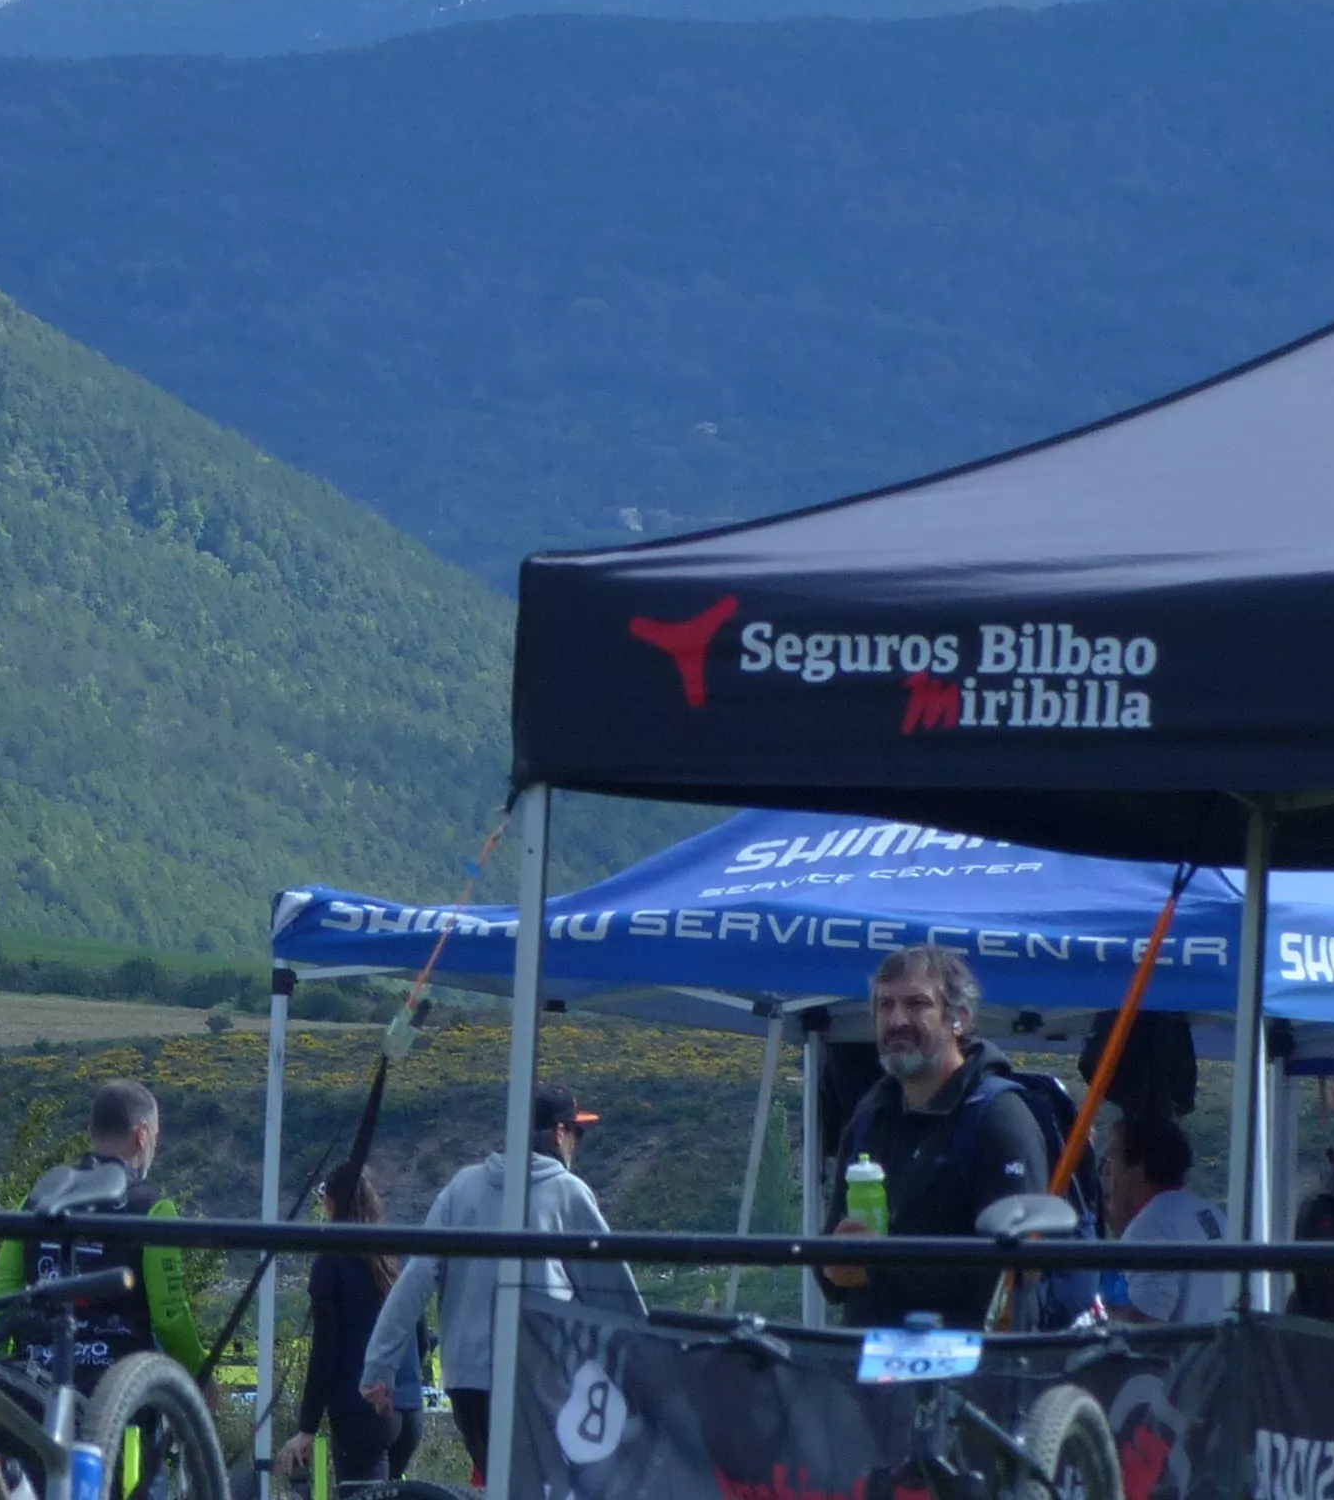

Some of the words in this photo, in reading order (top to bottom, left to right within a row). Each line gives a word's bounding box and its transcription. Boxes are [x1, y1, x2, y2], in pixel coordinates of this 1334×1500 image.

[740, 622, 959, 683] Seguros
[977, 623, 1157, 676] Bilbao
[902, 670, 1152, 735] Miribilla
[698, 872, 856, 898] SERVICE
[867, 862, 1043, 879] CENTER
[630, 909, 907, 950] SERVICE
[926, 924, 1228, 967] CENTER
